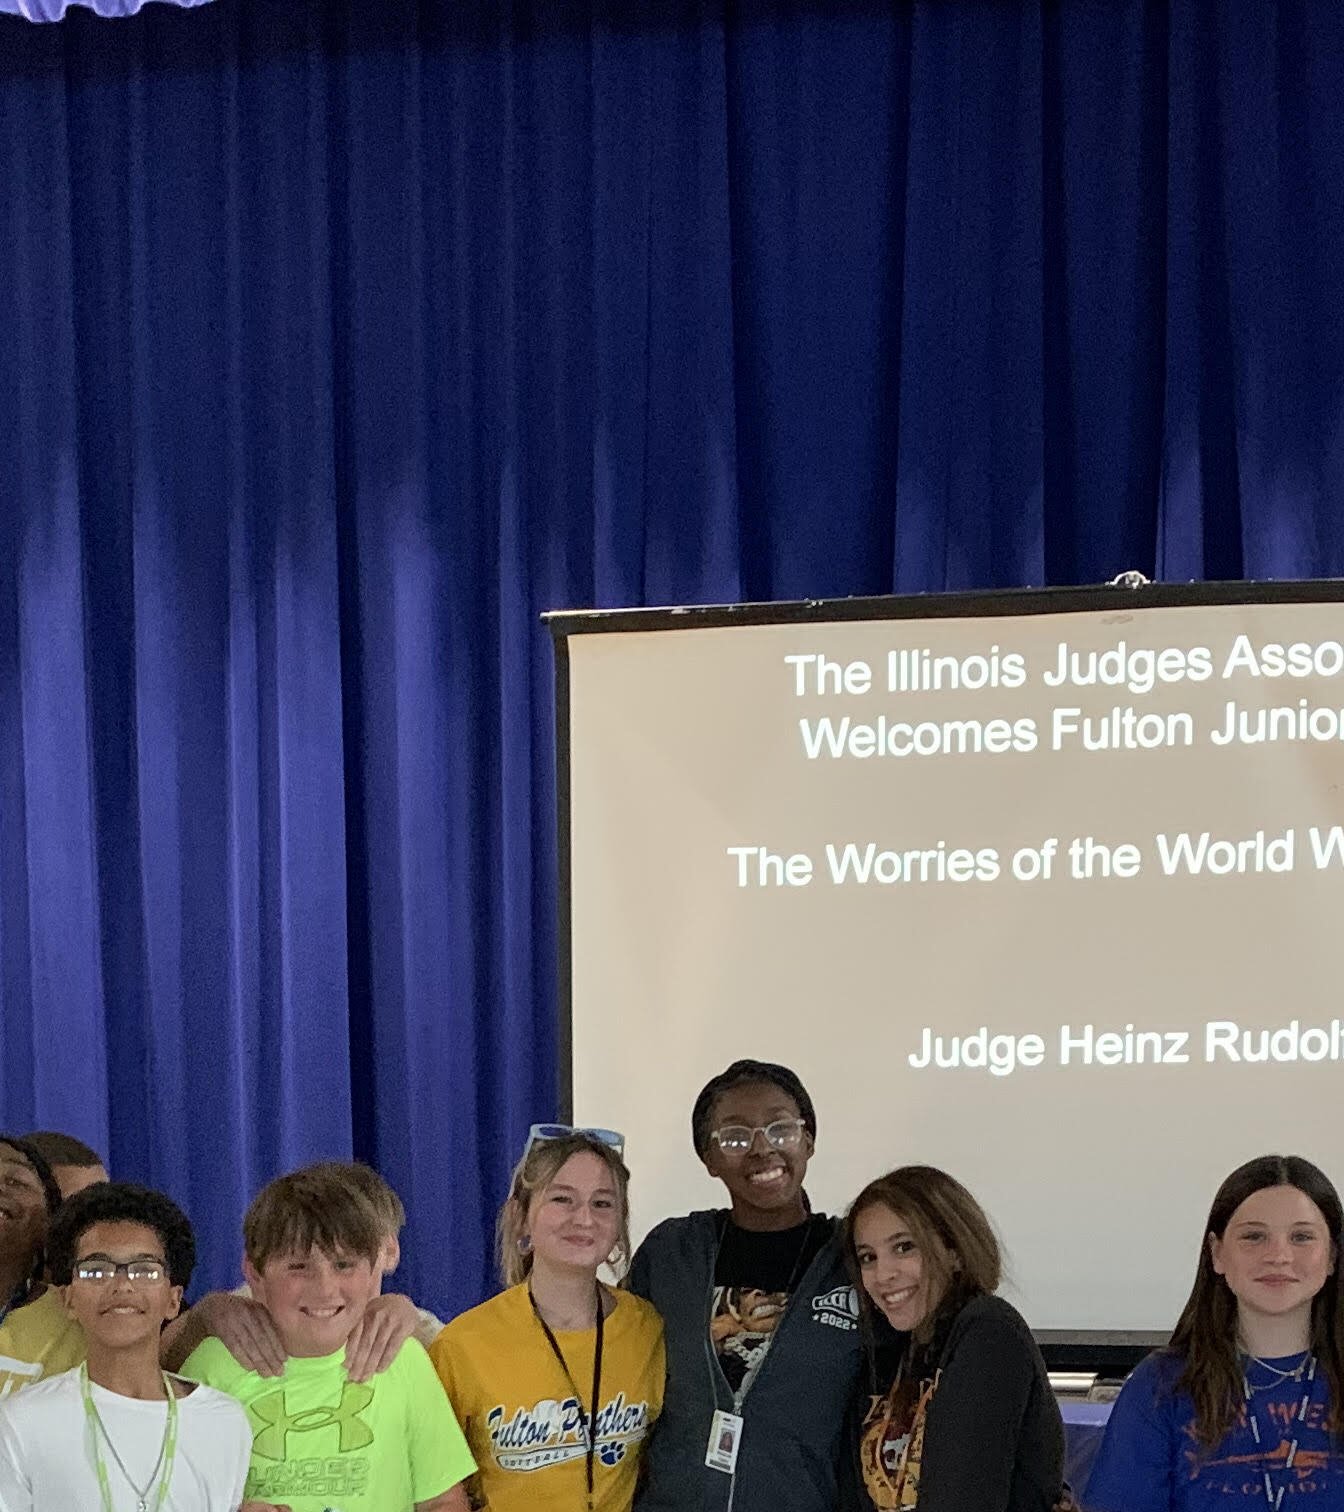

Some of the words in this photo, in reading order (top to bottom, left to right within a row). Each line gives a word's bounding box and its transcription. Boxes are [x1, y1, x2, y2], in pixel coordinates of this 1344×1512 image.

[783, 653, 873, 697] The
[887, 644, 1027, 693] Illinois
[1042, 640, 1214, 695] Judges
[798, 715, 1039, 760] Welcomes
[1052, 706, 1193, 751] Fulton
[726, 846, 814, 888] The
[825, 840, 1001, 885] Worries
[1011, 837, 1059, 881] of
[1067, 836, 1142, 880] the
[1155, 828, 1295, 876] World
[907, 1026, 1046, 1077] Judge
[1059, 1023, 1190, 1066] Heinz
[820, 1312, 851, 1330] 2022
[488, 1404, 553, 1450] Fulton
[248, 1456, 372, 1486] UNDER
